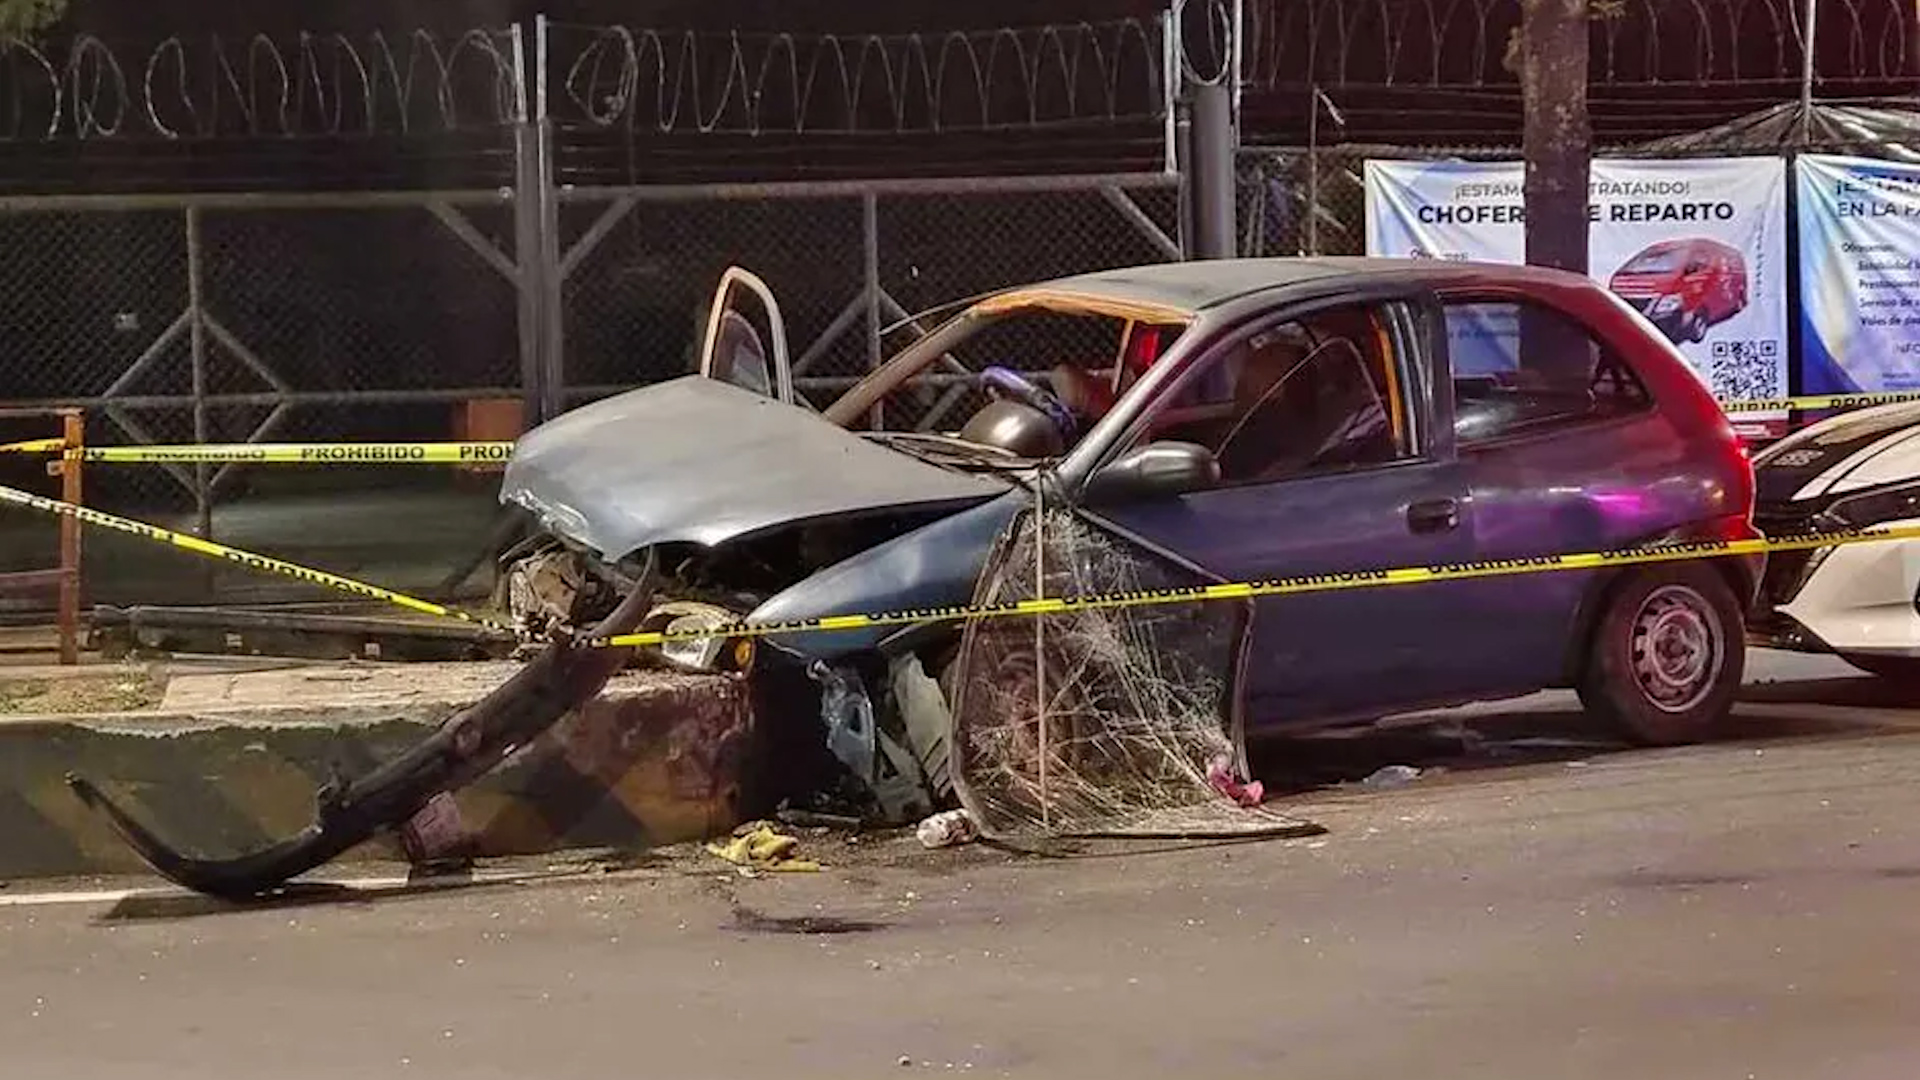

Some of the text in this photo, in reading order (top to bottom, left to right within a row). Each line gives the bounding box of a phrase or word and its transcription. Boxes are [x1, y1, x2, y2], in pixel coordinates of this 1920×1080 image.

[1610, 203, 1735, 222] REPARTO
[1838, 201, 1865, 217] EN
[1872, 201, 1898, 217] LA
[301, 445, 425, 459] PROHIBIDO
